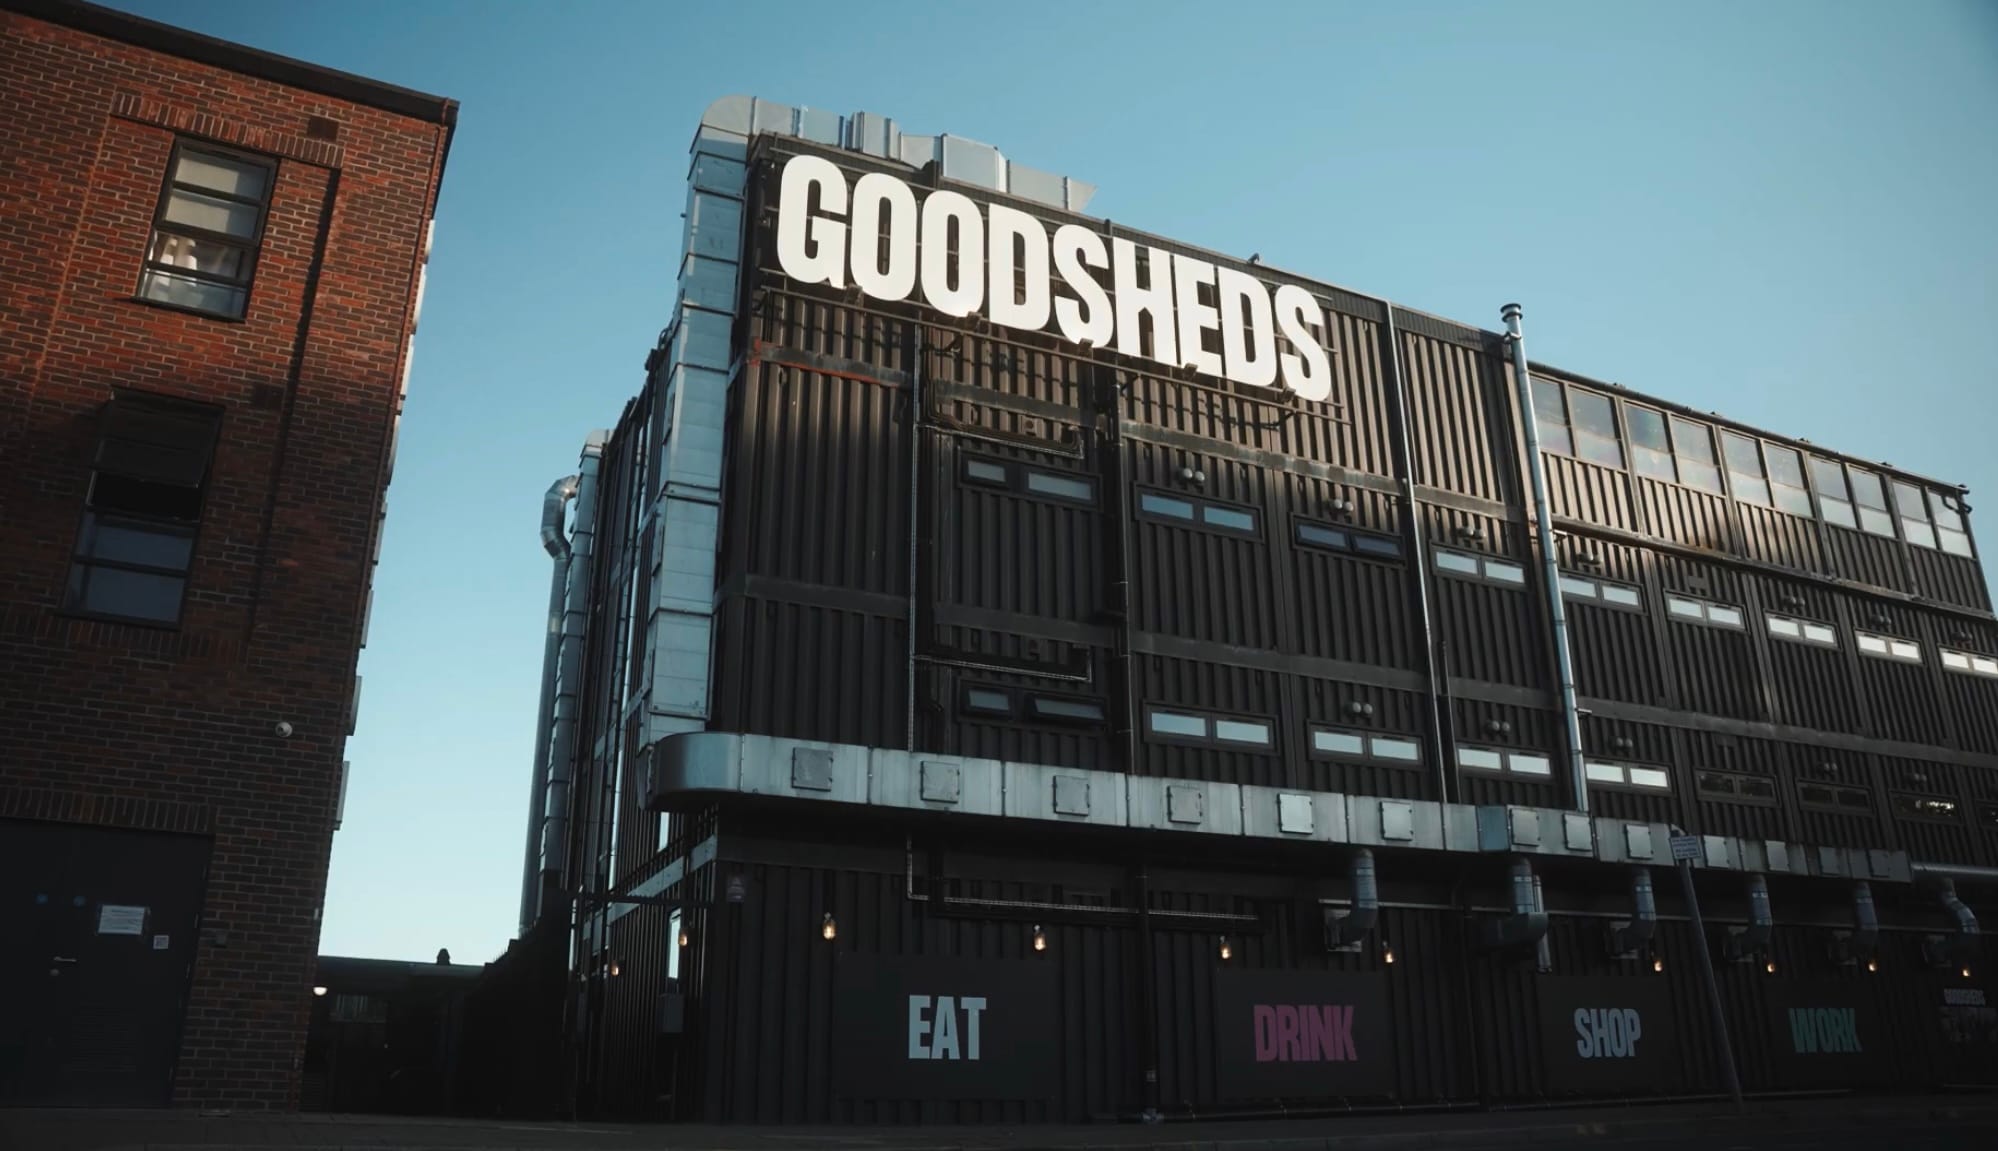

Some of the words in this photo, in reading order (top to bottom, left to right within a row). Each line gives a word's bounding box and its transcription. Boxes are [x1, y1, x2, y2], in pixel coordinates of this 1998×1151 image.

[777, 155, 1332, 402] GOODSHEDS
[909, 996, 987, 1059] EAT
[1254, 1005, 1356, 1061] DRINK
[1575, 1008, 1641, 1058] SHOP
[1789, 1007, 1862, 1053] WORK
